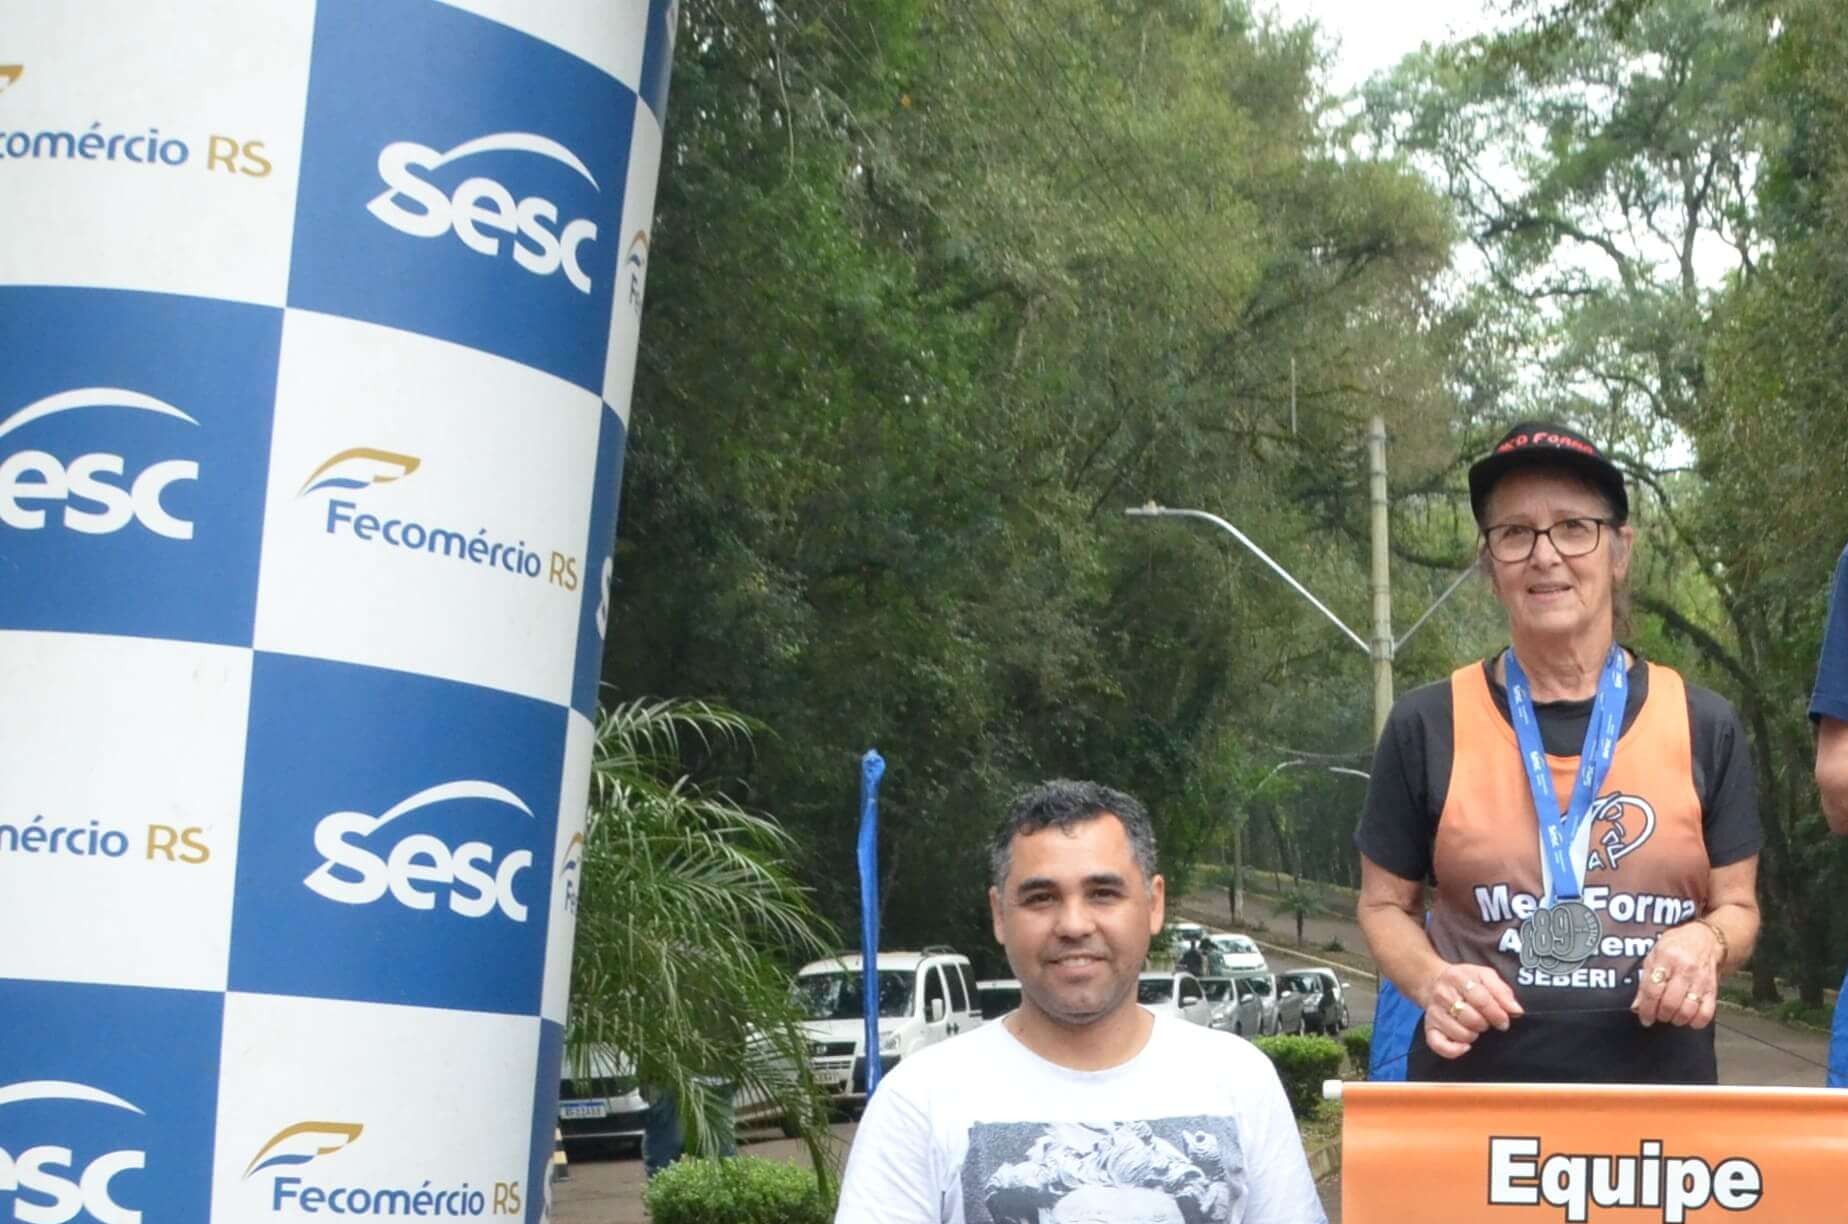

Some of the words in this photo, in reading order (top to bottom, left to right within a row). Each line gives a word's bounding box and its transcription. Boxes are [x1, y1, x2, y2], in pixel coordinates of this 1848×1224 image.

[0, 121, 190, 166] omércio
[207, 135, 273, 178] RS
[367, 141, 597, 294] Sesc
[326, 499, 542, 579] Fecomércio
[549, 552, 578, 592] RS
[146, 823, 210, 865] RS
[303, 811, 533, 922] Sesc
[272, 1176, 485, 1217] Fecomércio
[492, 1181, 521, 1217] RS
[1487, 1136, 1762, 1224] Equipe
